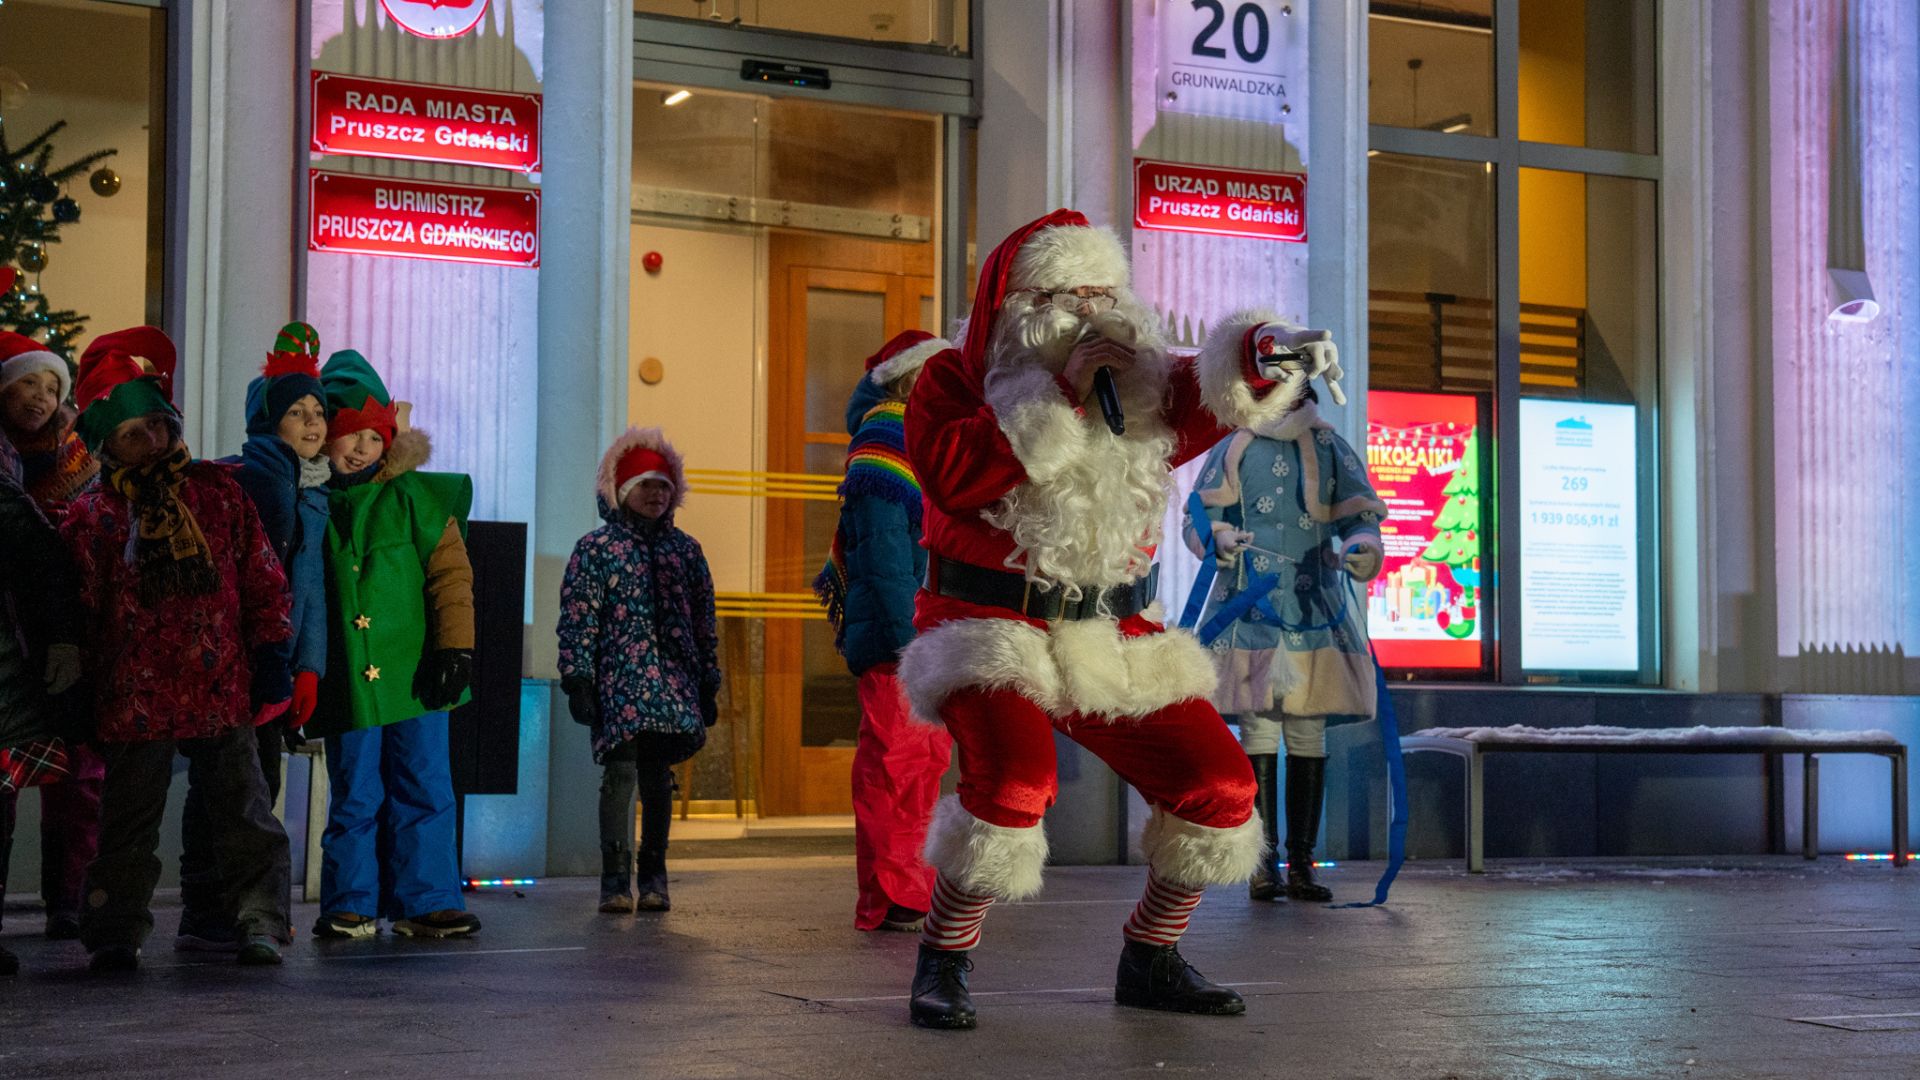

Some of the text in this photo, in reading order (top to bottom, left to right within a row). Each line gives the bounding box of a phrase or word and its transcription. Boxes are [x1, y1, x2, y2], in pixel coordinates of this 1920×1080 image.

[1191, 0, 1269, 63] 20
[1172, 71, 1287, 97] GRUNWALDZKA
[345, 90, 516, 126] RADA MIASTA
[330, 116, 529, 153] Pruszcz Gdański
[375, 188, 485, 218] BURMISTRZ
[1154, 174, 1295, 204] URZĄD MIASTA
[1149, 196, 1299, 226] Pruszcz Gdański
[318, 215, 535, 254] PRUSZCZA GDAŃSKIEGO
[1561, 475, 1588, 491] 269
[1532, 512, 1537, 524] 1
[1541, 512, 1563, 525] 939
